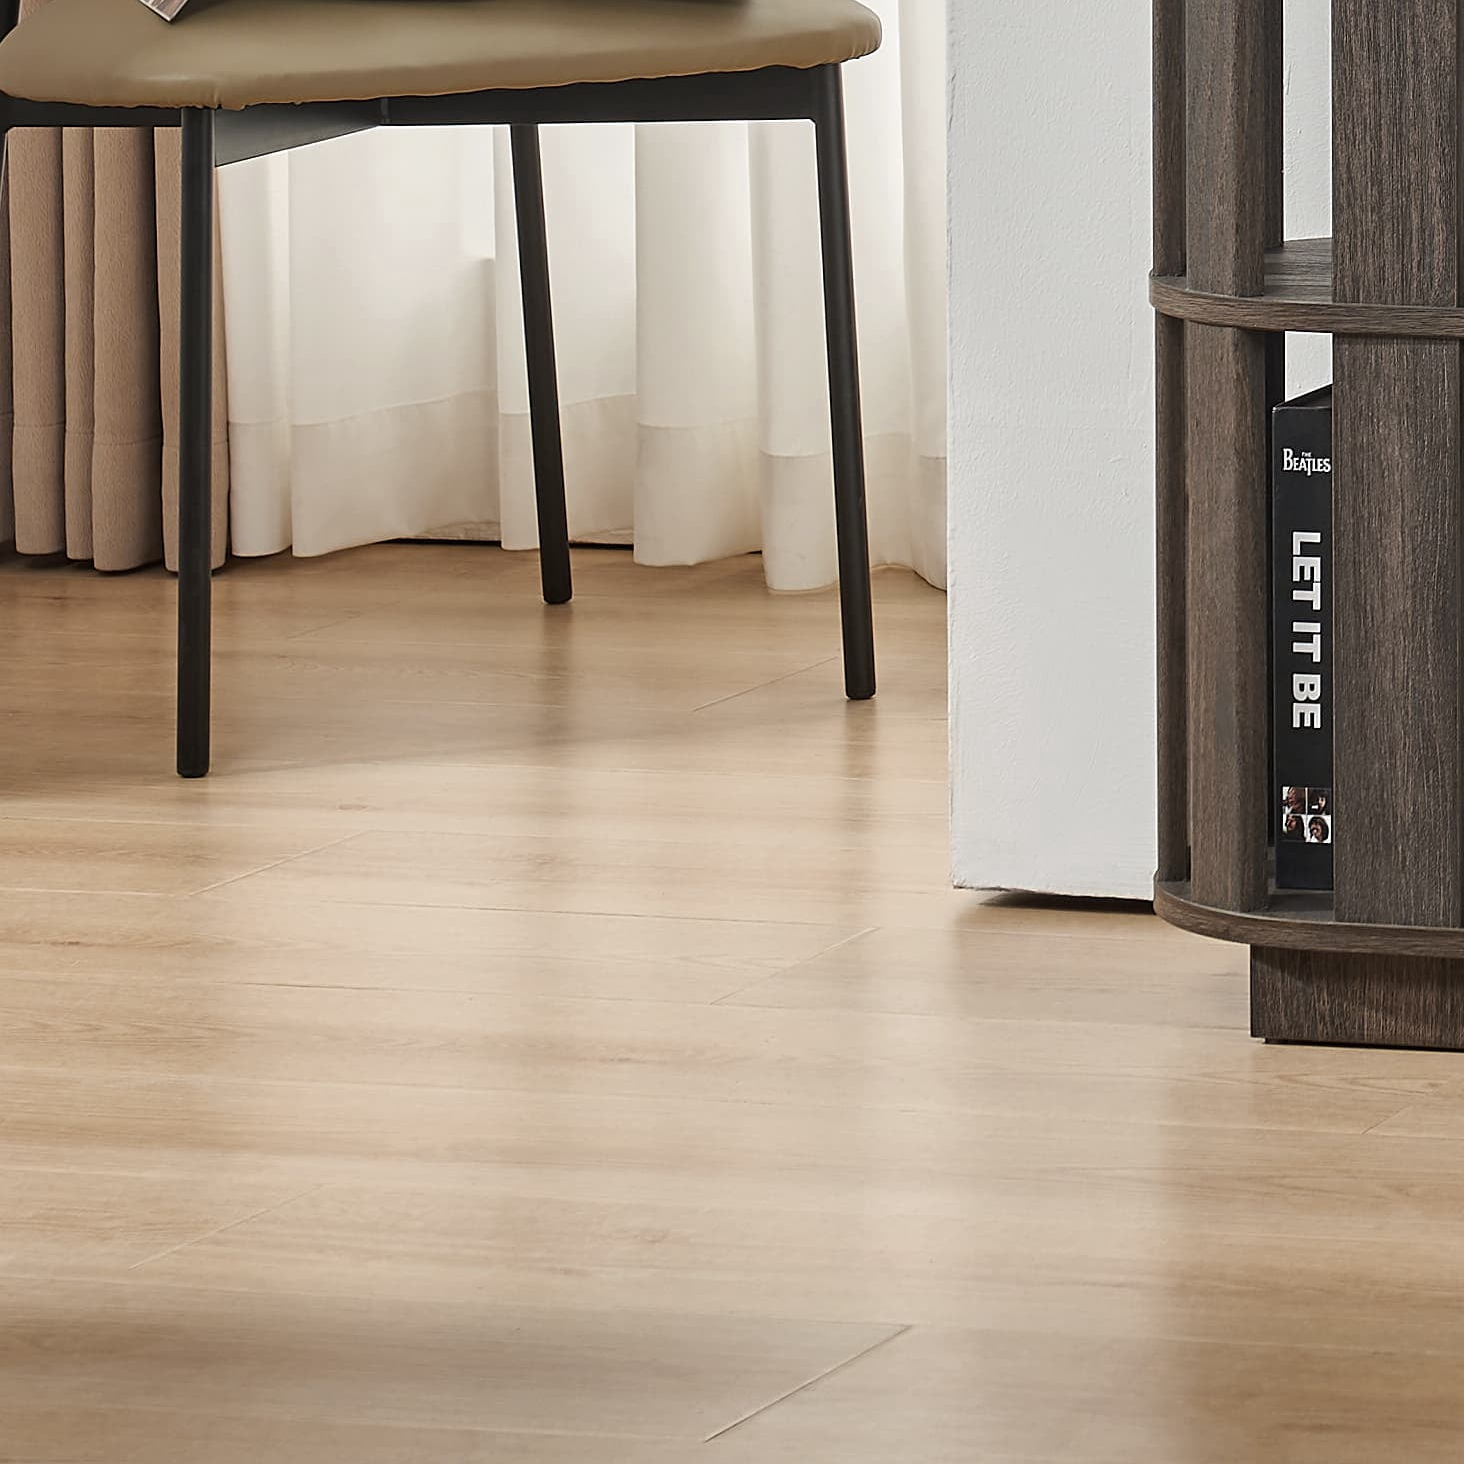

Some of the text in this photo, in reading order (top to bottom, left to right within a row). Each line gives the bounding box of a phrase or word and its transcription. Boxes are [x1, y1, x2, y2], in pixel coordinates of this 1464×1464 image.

[1292, 531, 1322, 729] LET IT BE
